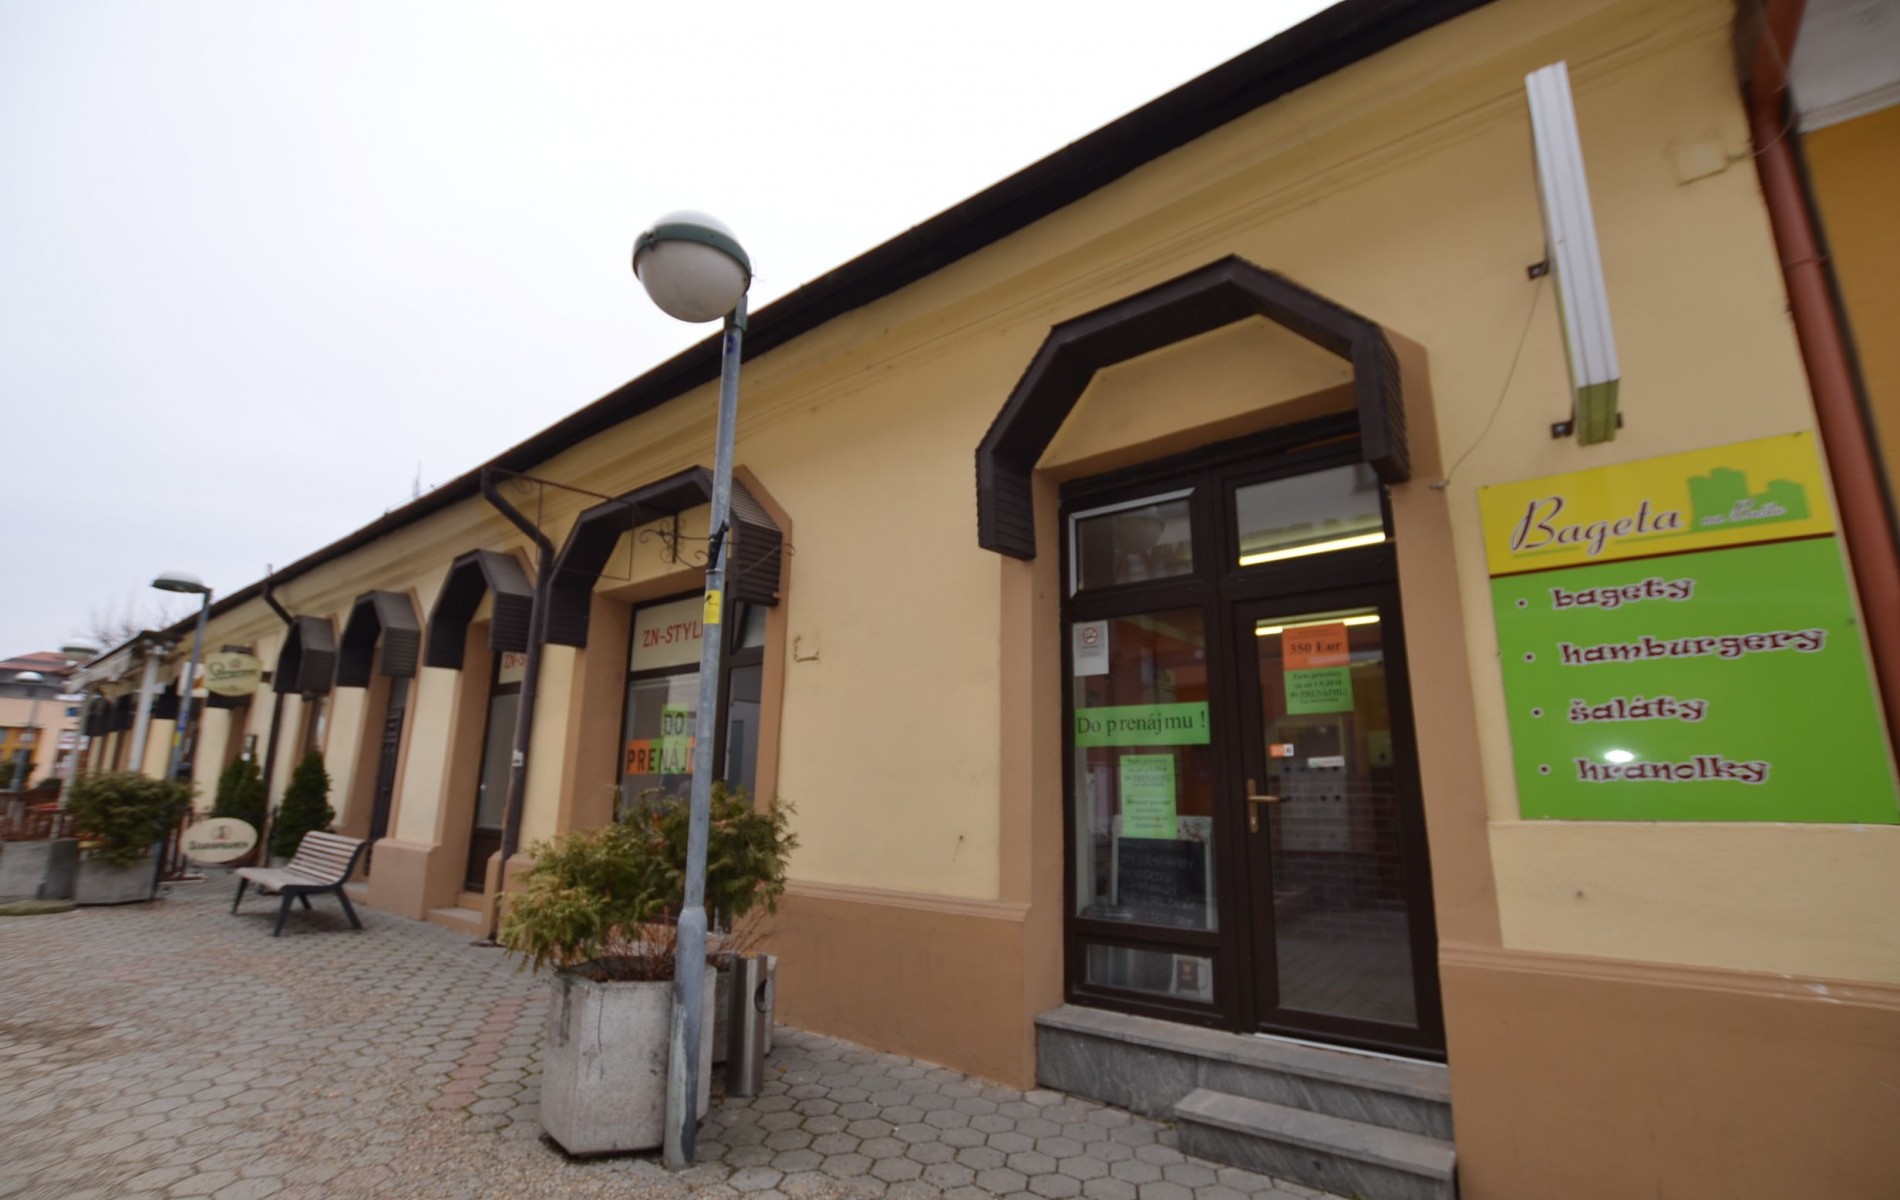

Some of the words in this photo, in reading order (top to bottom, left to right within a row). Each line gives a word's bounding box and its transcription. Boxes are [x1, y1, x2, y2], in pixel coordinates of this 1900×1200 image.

[1511, 495, 1682, 556] Bageta
[1551, 577, 1695, 609] bagety
[642, 619, 704, 649] ZN-STYL
[1560, 629, 1827, 664] hamburgery
[663, 711, 684, 735] DO
[1570, 695, 1707, 722] šaláty
[1077, 716, 1101, 734] Do
[1106, 711, 1194, 737] prenájmu
[1574, 755, 1771, 785] hranolky
